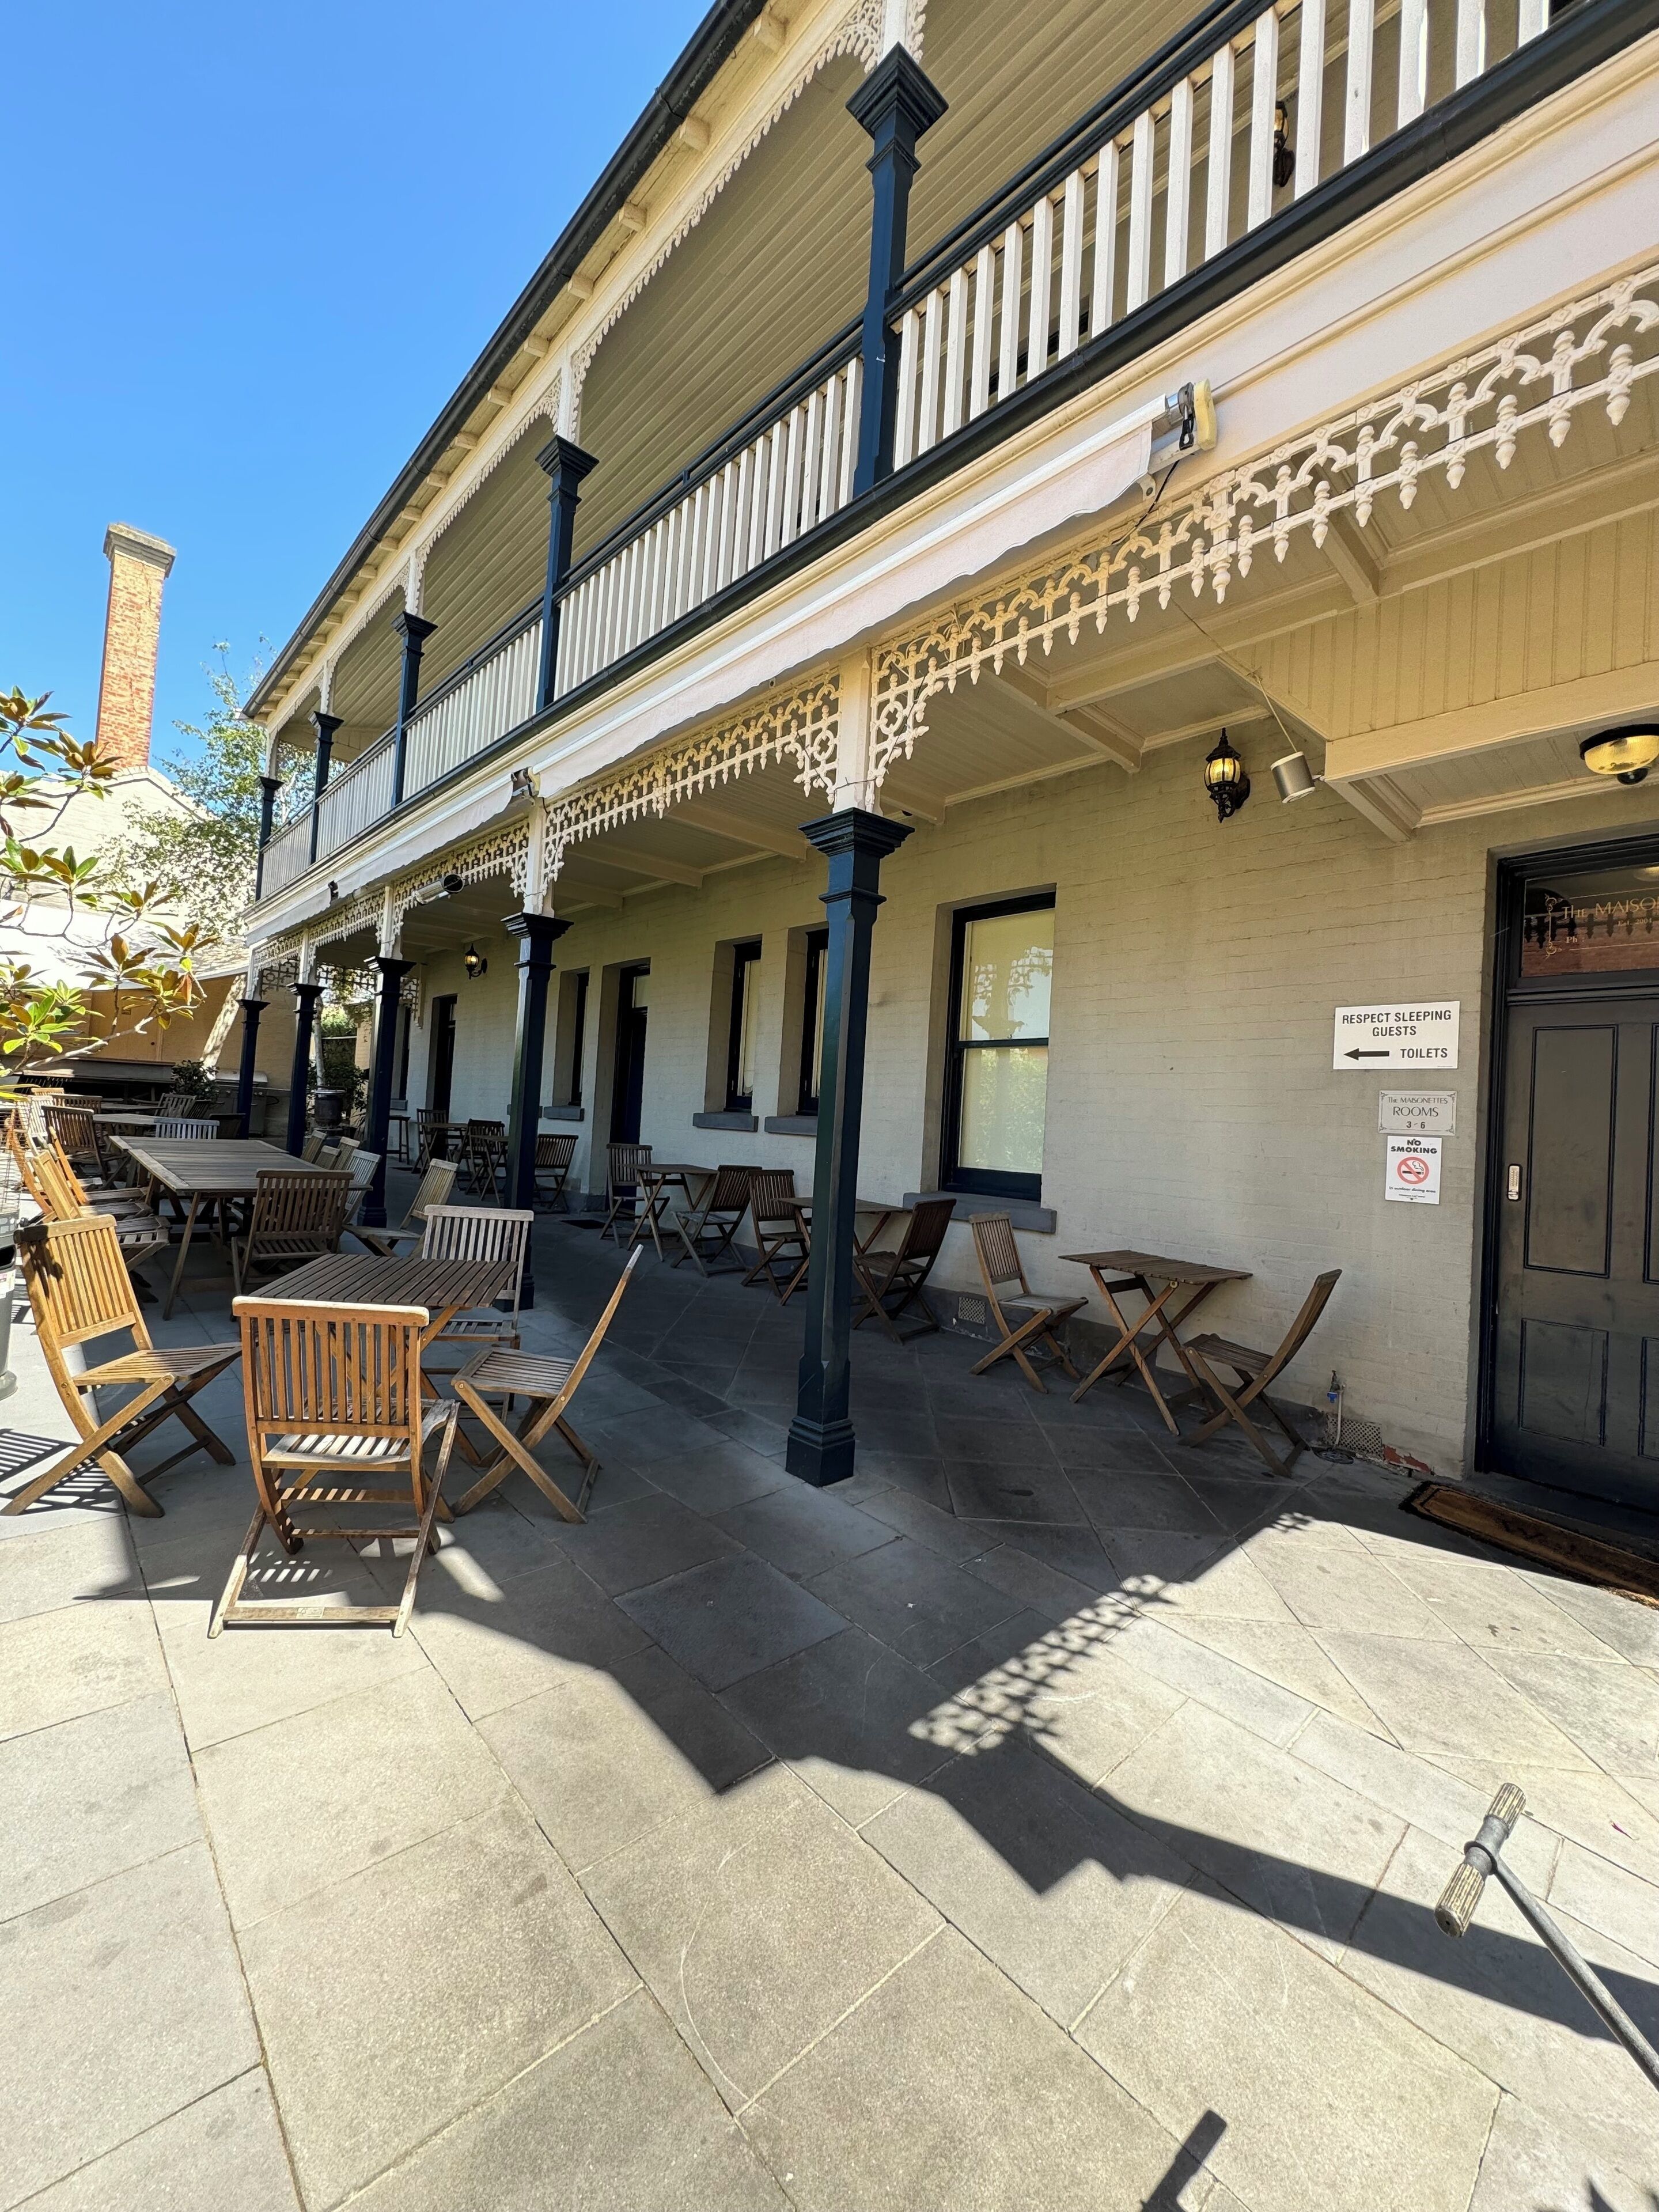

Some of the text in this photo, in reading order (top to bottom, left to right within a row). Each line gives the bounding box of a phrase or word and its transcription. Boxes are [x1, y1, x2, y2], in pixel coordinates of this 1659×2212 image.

[1596, 896, 1659, 915] MAISO
[1342, 1010, 1451, 1024] RESPECT SLEEPING
[1372, 1025, 1416, 1036] GUESTS
[1400, 1048, 1448, 1059] TOILETS
[1392, 1106, 1439, 1117] ROOMS
[1391, 1146, 1437, 1154] SMOKING
